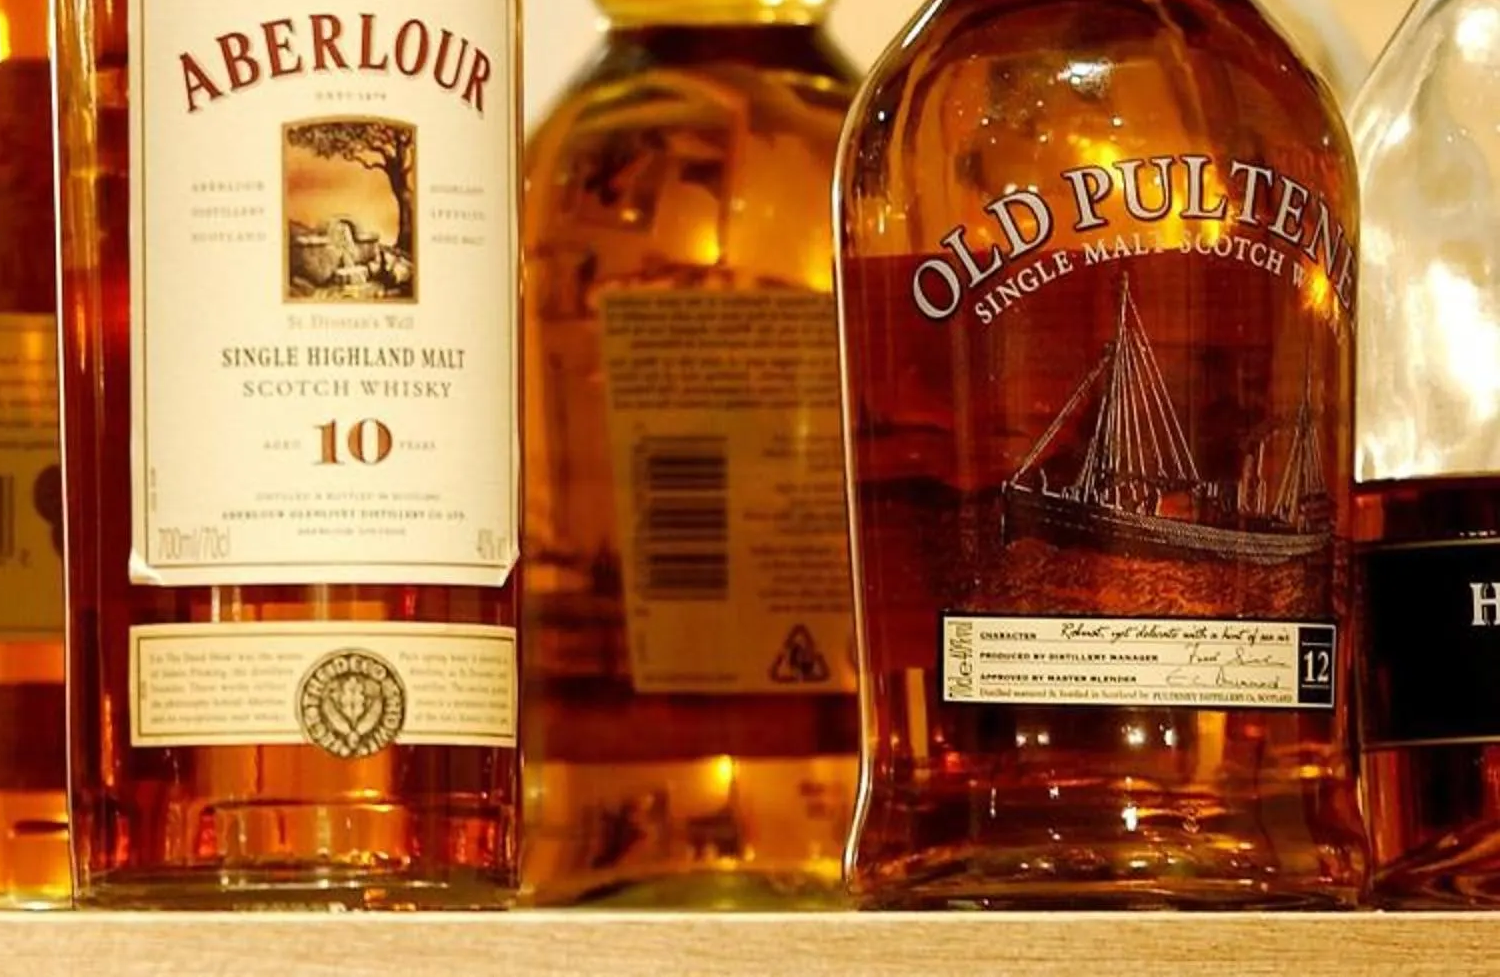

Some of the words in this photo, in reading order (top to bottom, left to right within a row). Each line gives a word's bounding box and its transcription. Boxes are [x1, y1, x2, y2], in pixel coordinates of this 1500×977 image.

[179, 13, 492, 114] ABERLOUR
[911, 188, 1054, 321] OLD
[974, 254, 1074, 324] SINGLE
[1084, 233, 1164, 267] MALT
[1179, 230, 1284, 273] SCOTCH
[222, 347, 299, 368] SINGLE
[307, 347, 416, 368] HIGHLAND
[421, 349, 466, 370] MALT
[243, 380, 350, 398] SCOTCH
[361, 380, 453, 399] WHISKY
[311, 417, 393, 466] 10
[980, 652, 1030, 660] PRODUCED
[1110, 654, 1159, 662] MANAGER
[1303, 650, 1330, 683] 12
[980, 673, 1029, 681] APPROVED
[1047, 674, 1087, 682] MASTER
[1090, 675, 1137, 683] BLENDER
